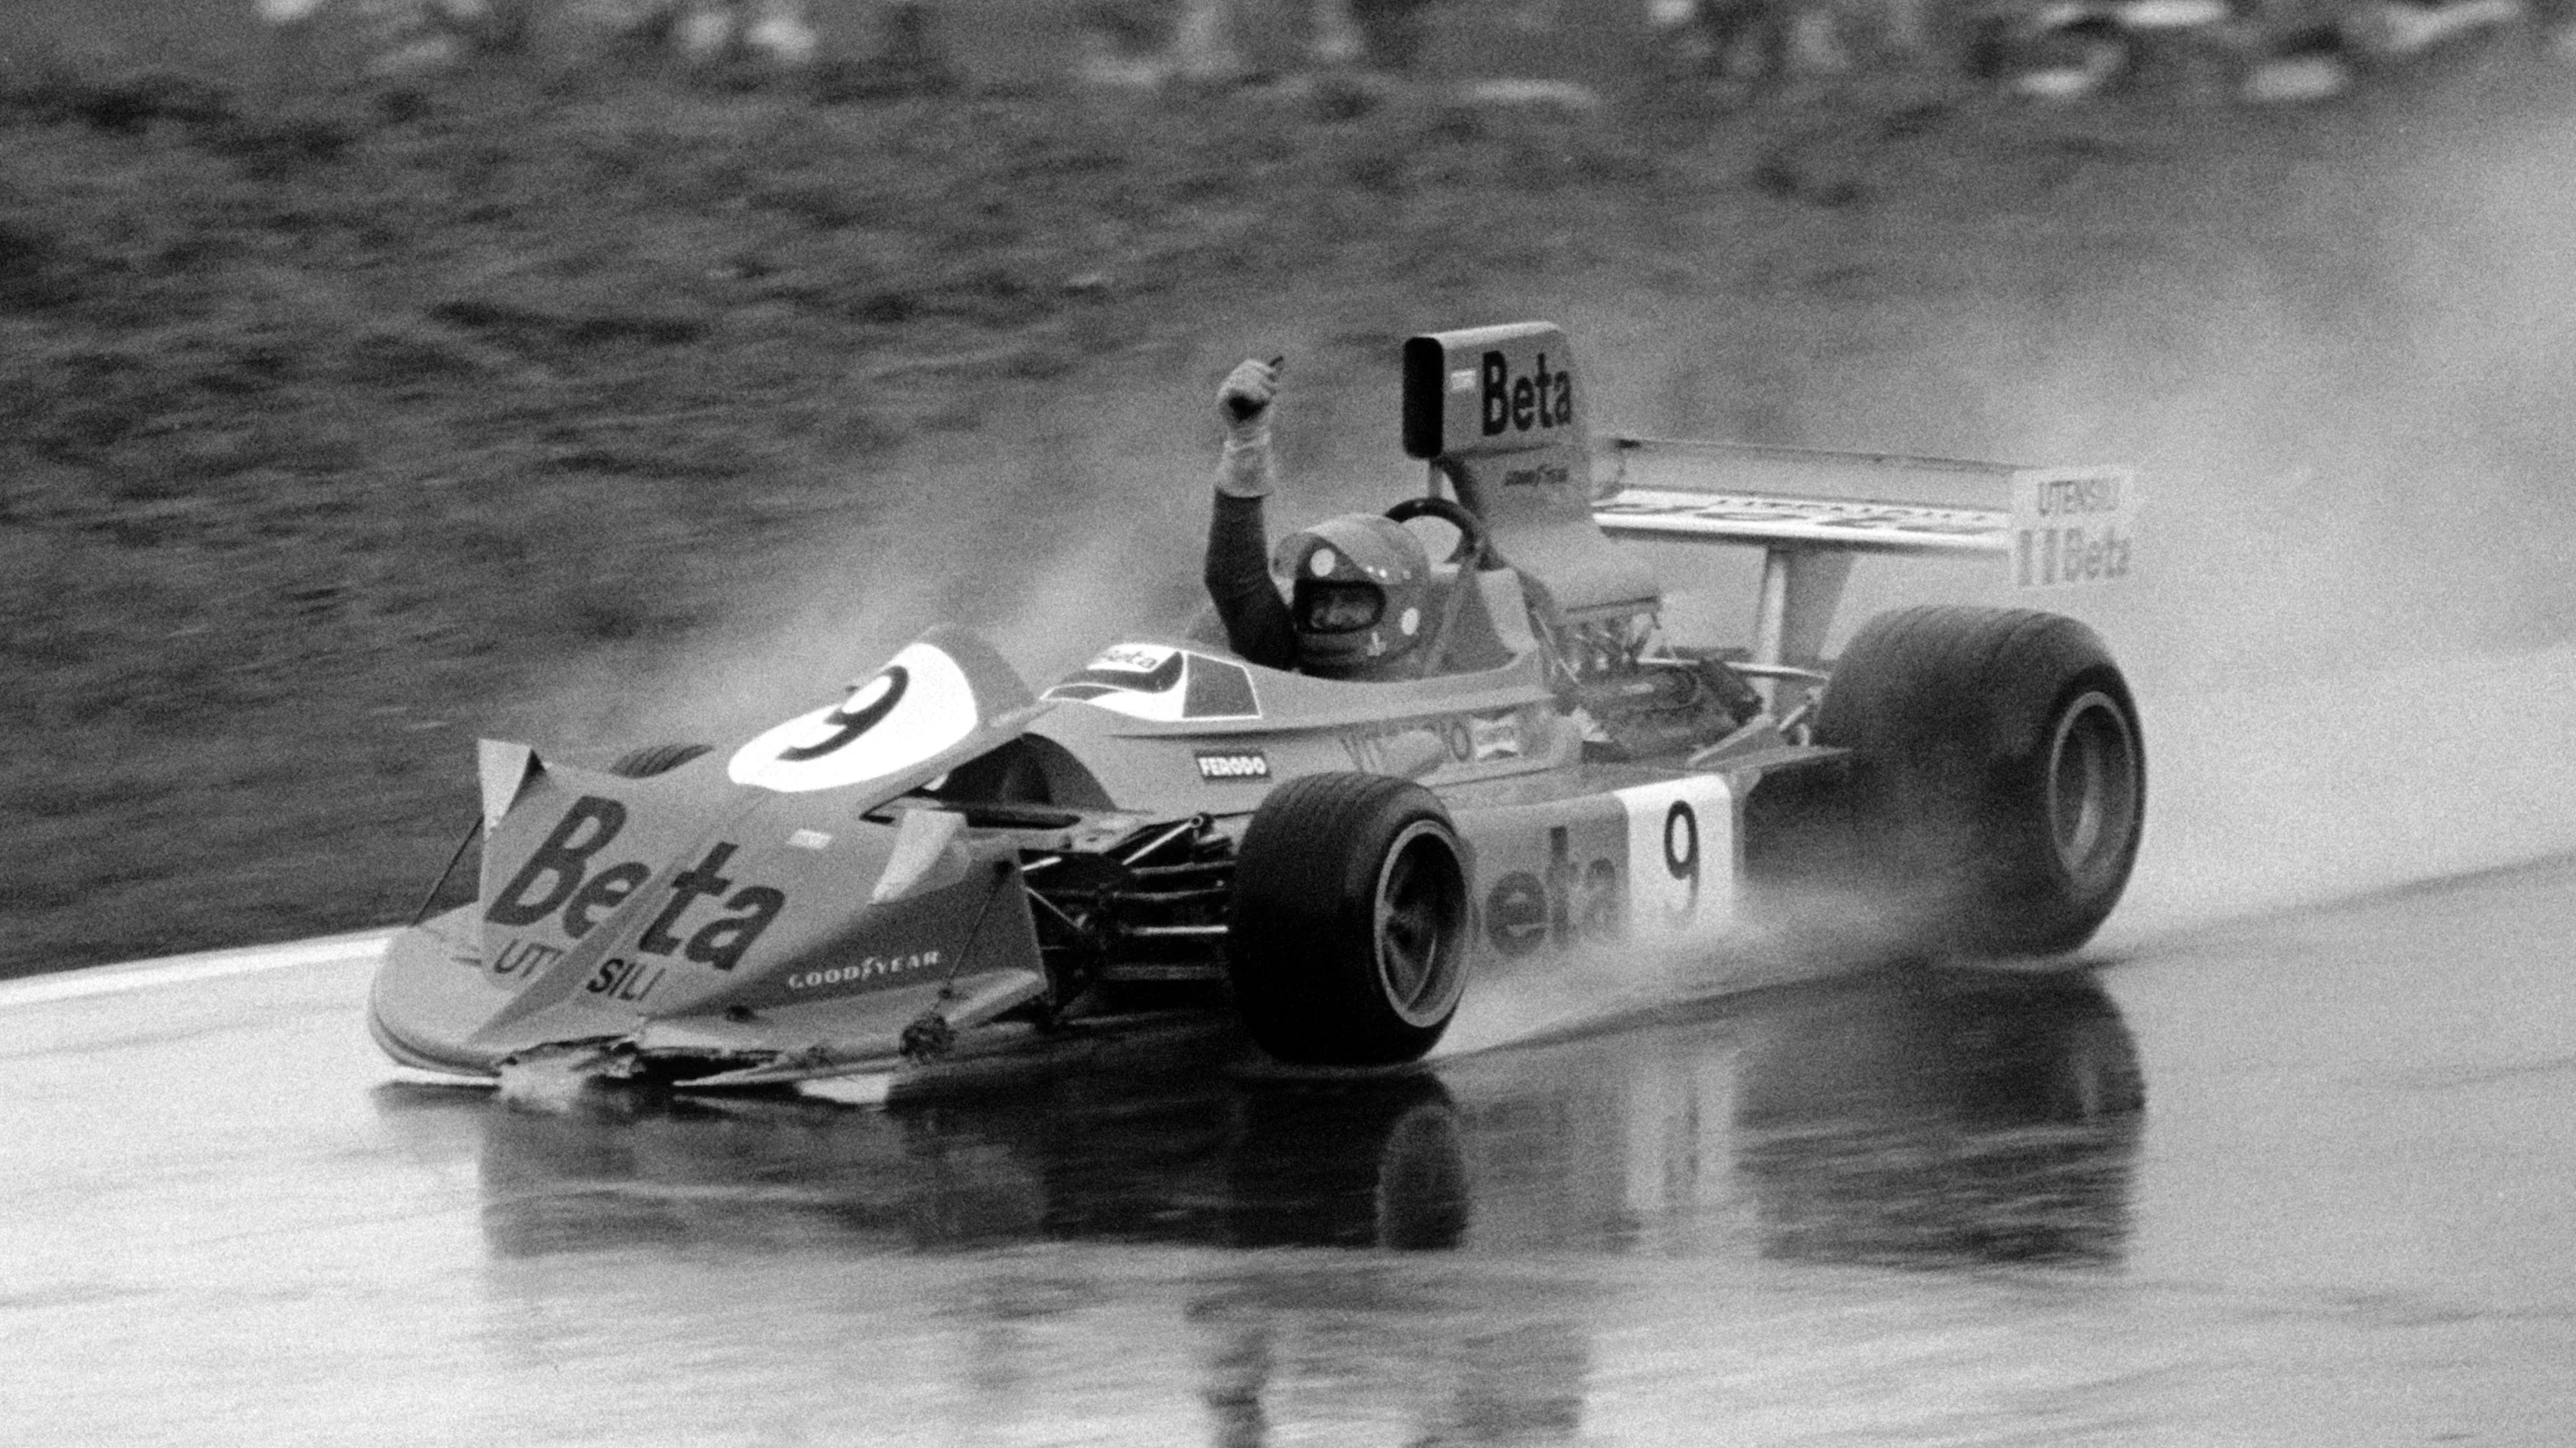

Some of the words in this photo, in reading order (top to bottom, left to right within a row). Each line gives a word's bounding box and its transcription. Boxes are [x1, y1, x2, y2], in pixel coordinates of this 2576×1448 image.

[1483, 350, 1571, 437] Beta
[2063, 527, 2131, 582] Beta
[775, 665, 909, 762] 9
[1198, 756, 1266, 776] FERODO
[485, 796, 784, 971] Beta
[1485, 825, 1621, 957] eta
[1664, 800, 1700, 911] 9
[788, 951, 941, 989] GOODYEAR
